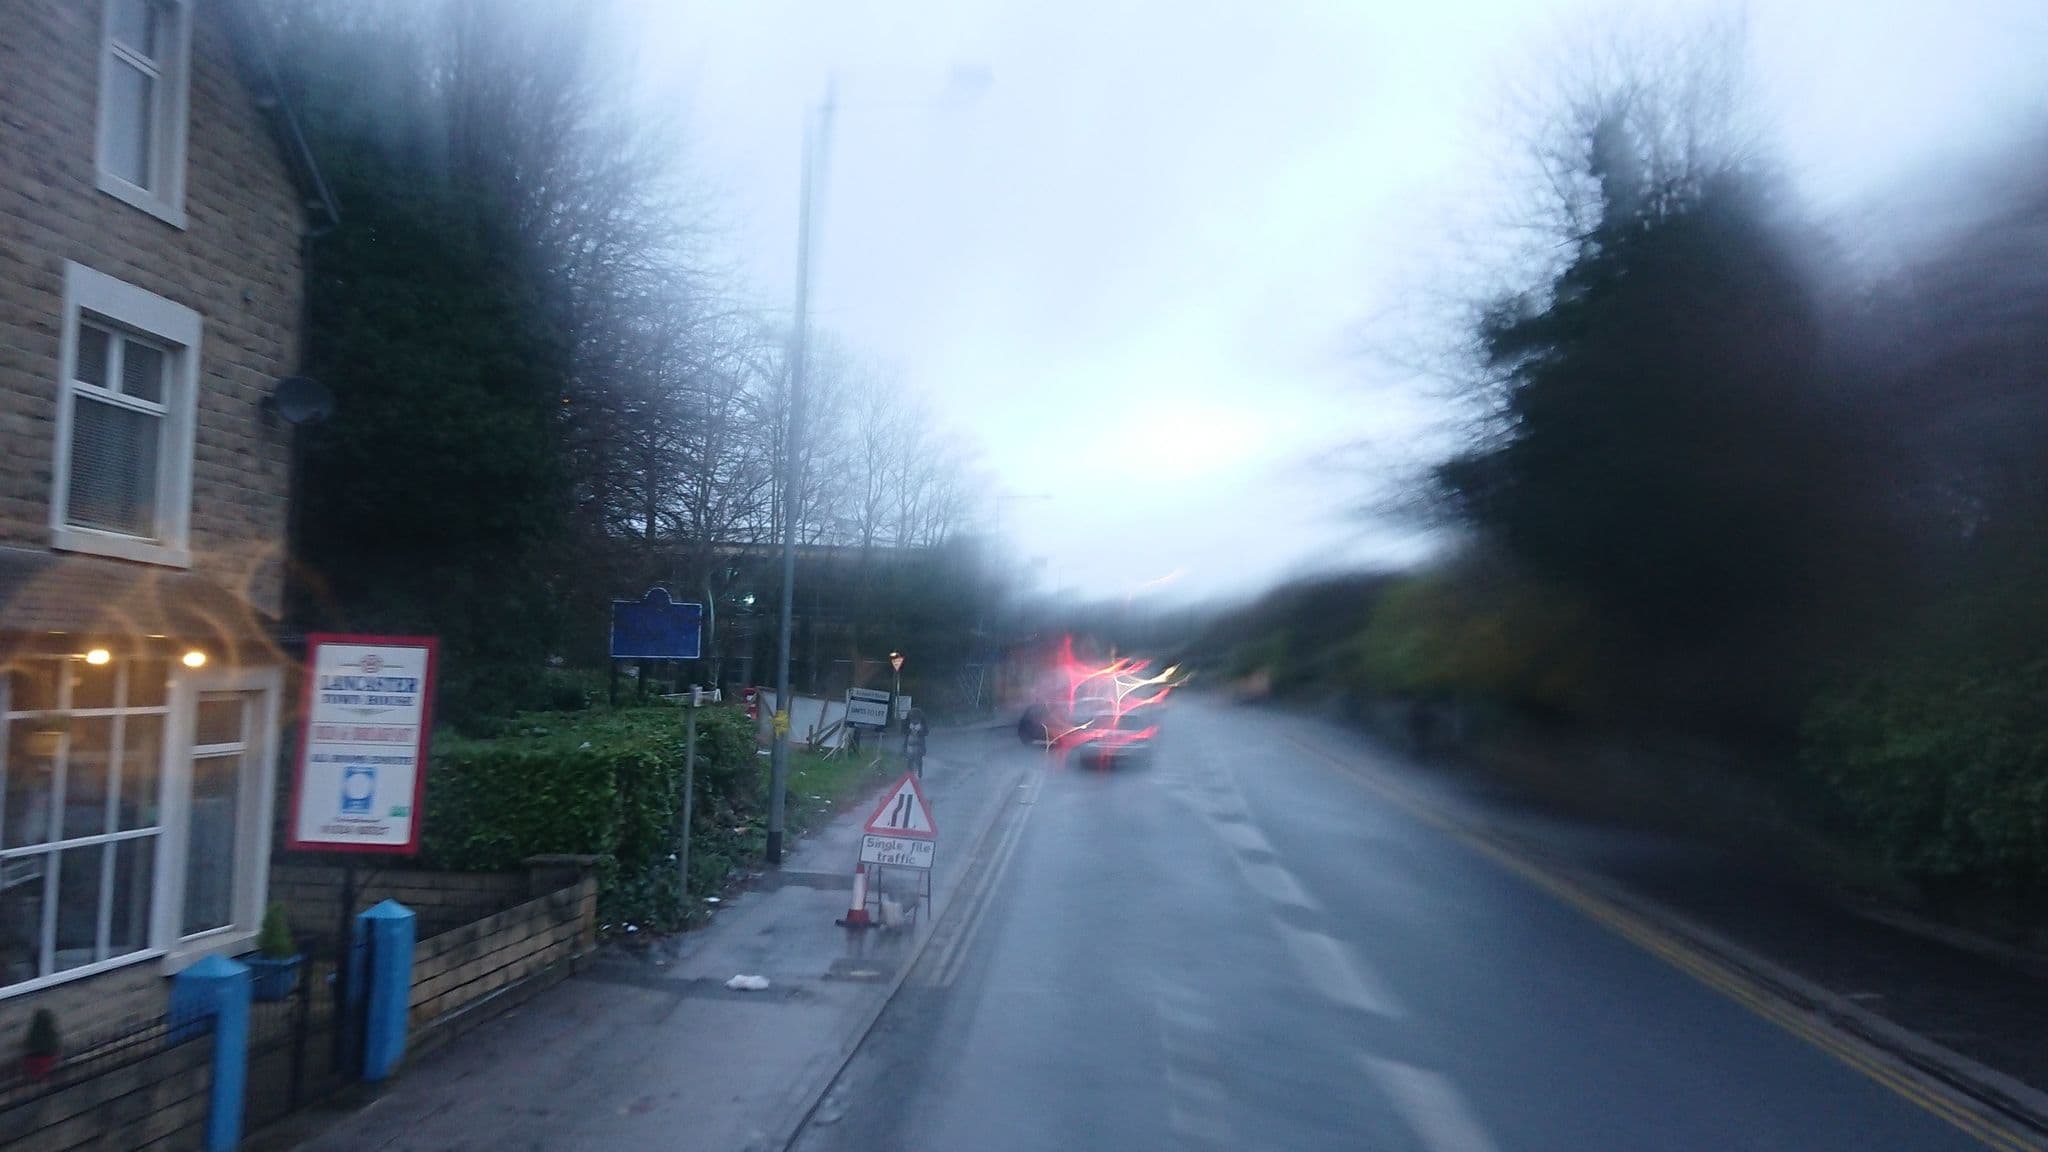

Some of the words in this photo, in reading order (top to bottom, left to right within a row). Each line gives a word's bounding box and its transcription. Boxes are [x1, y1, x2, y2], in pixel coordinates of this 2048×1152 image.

[320, 675, 418, 693] LANCASTER
[867, 837, 903, 851] Single
[911, 841, 931, 855] file
[877, 852, 915, 864] traffic
